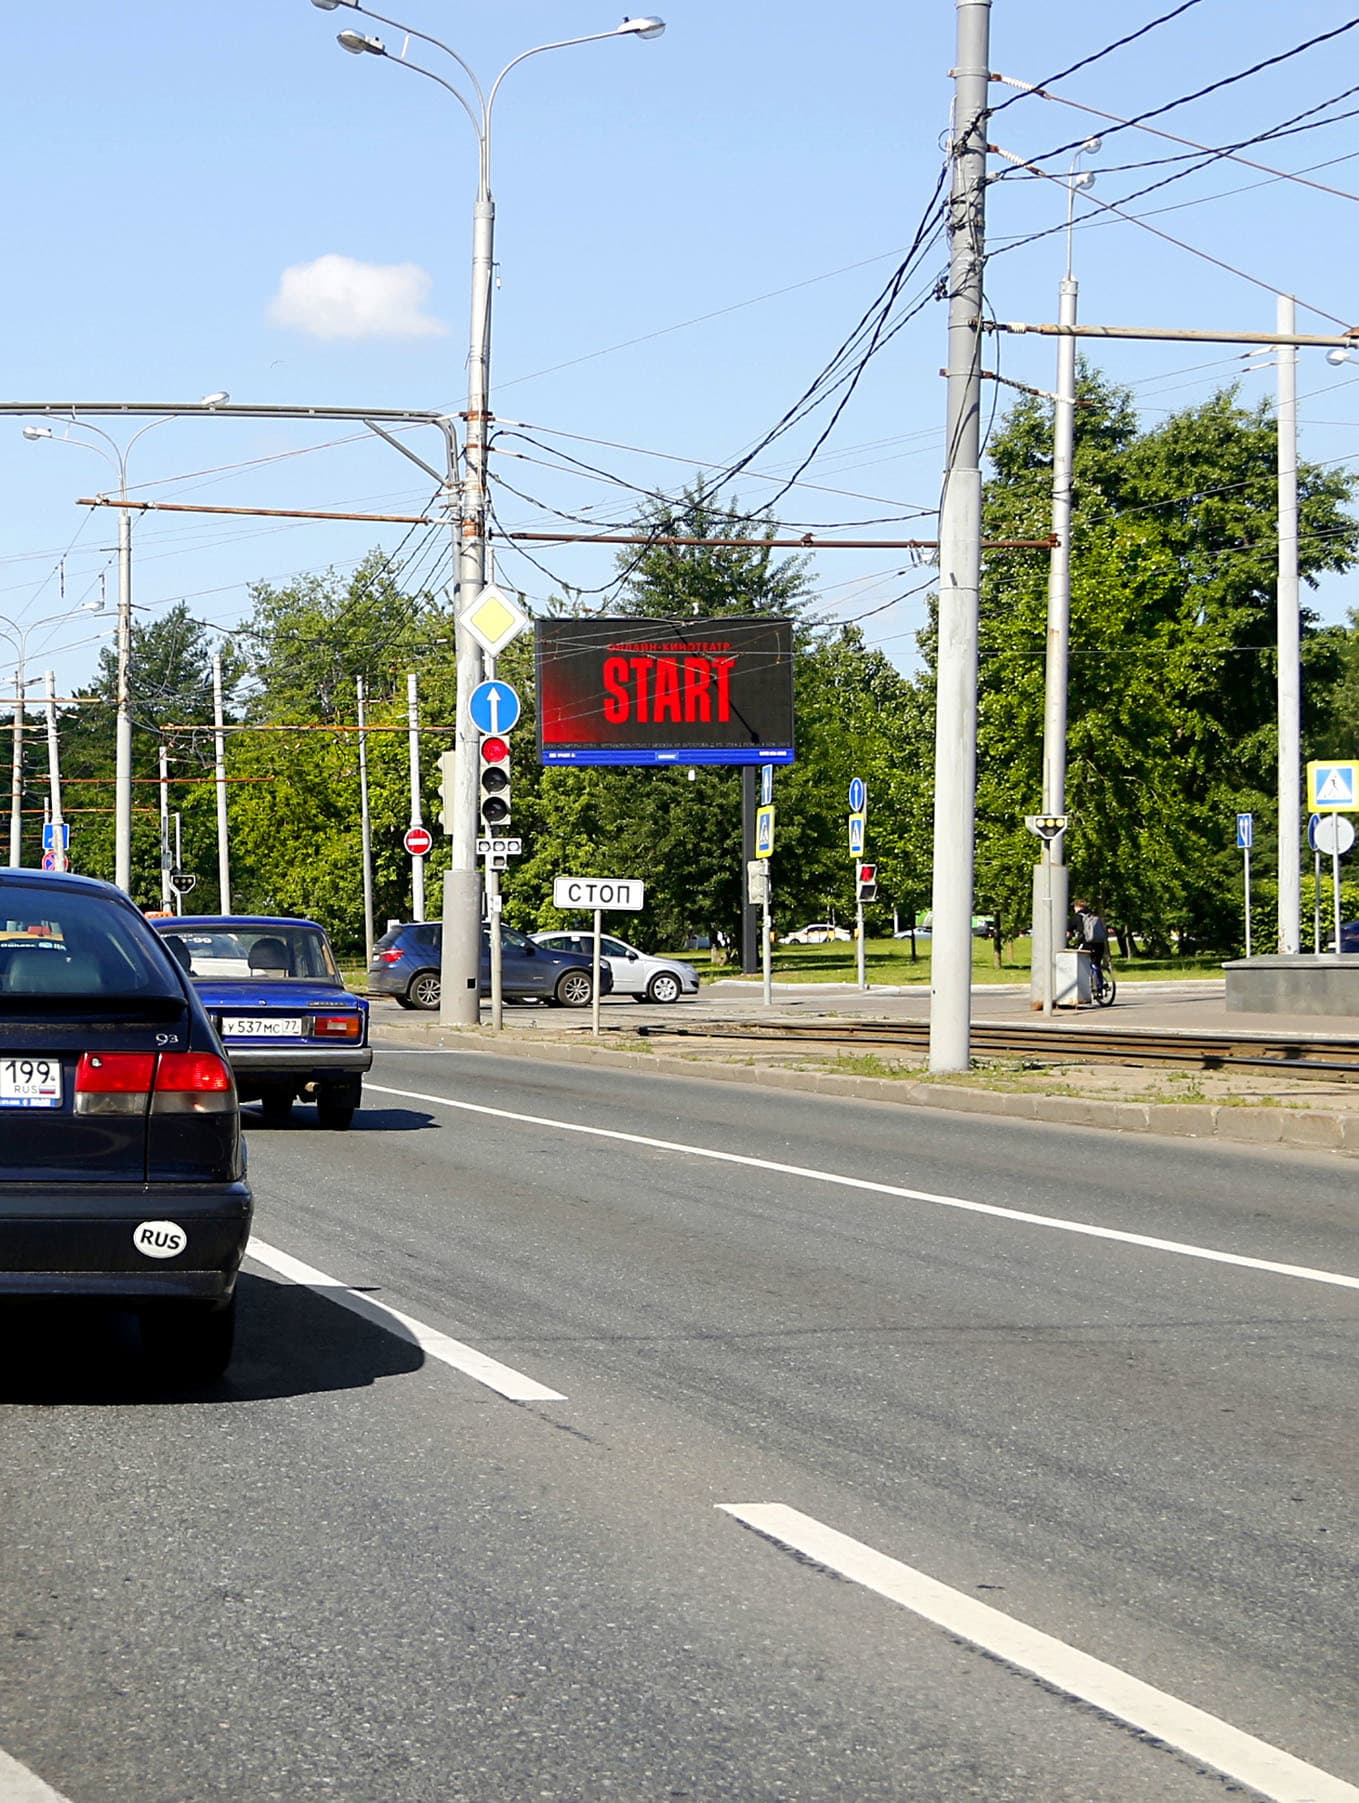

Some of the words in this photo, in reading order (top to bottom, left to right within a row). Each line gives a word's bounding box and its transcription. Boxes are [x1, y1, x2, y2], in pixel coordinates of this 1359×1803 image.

[603, 656, 736, 723] START
[568, 883, 630, 904] СТОП
[284, 1020, 297, 1030] 77
[5, 1061, 50, 1084] 199
[14, 1085, 37, 1093] RUS
[140, 1228, 181, 1250] RUS
